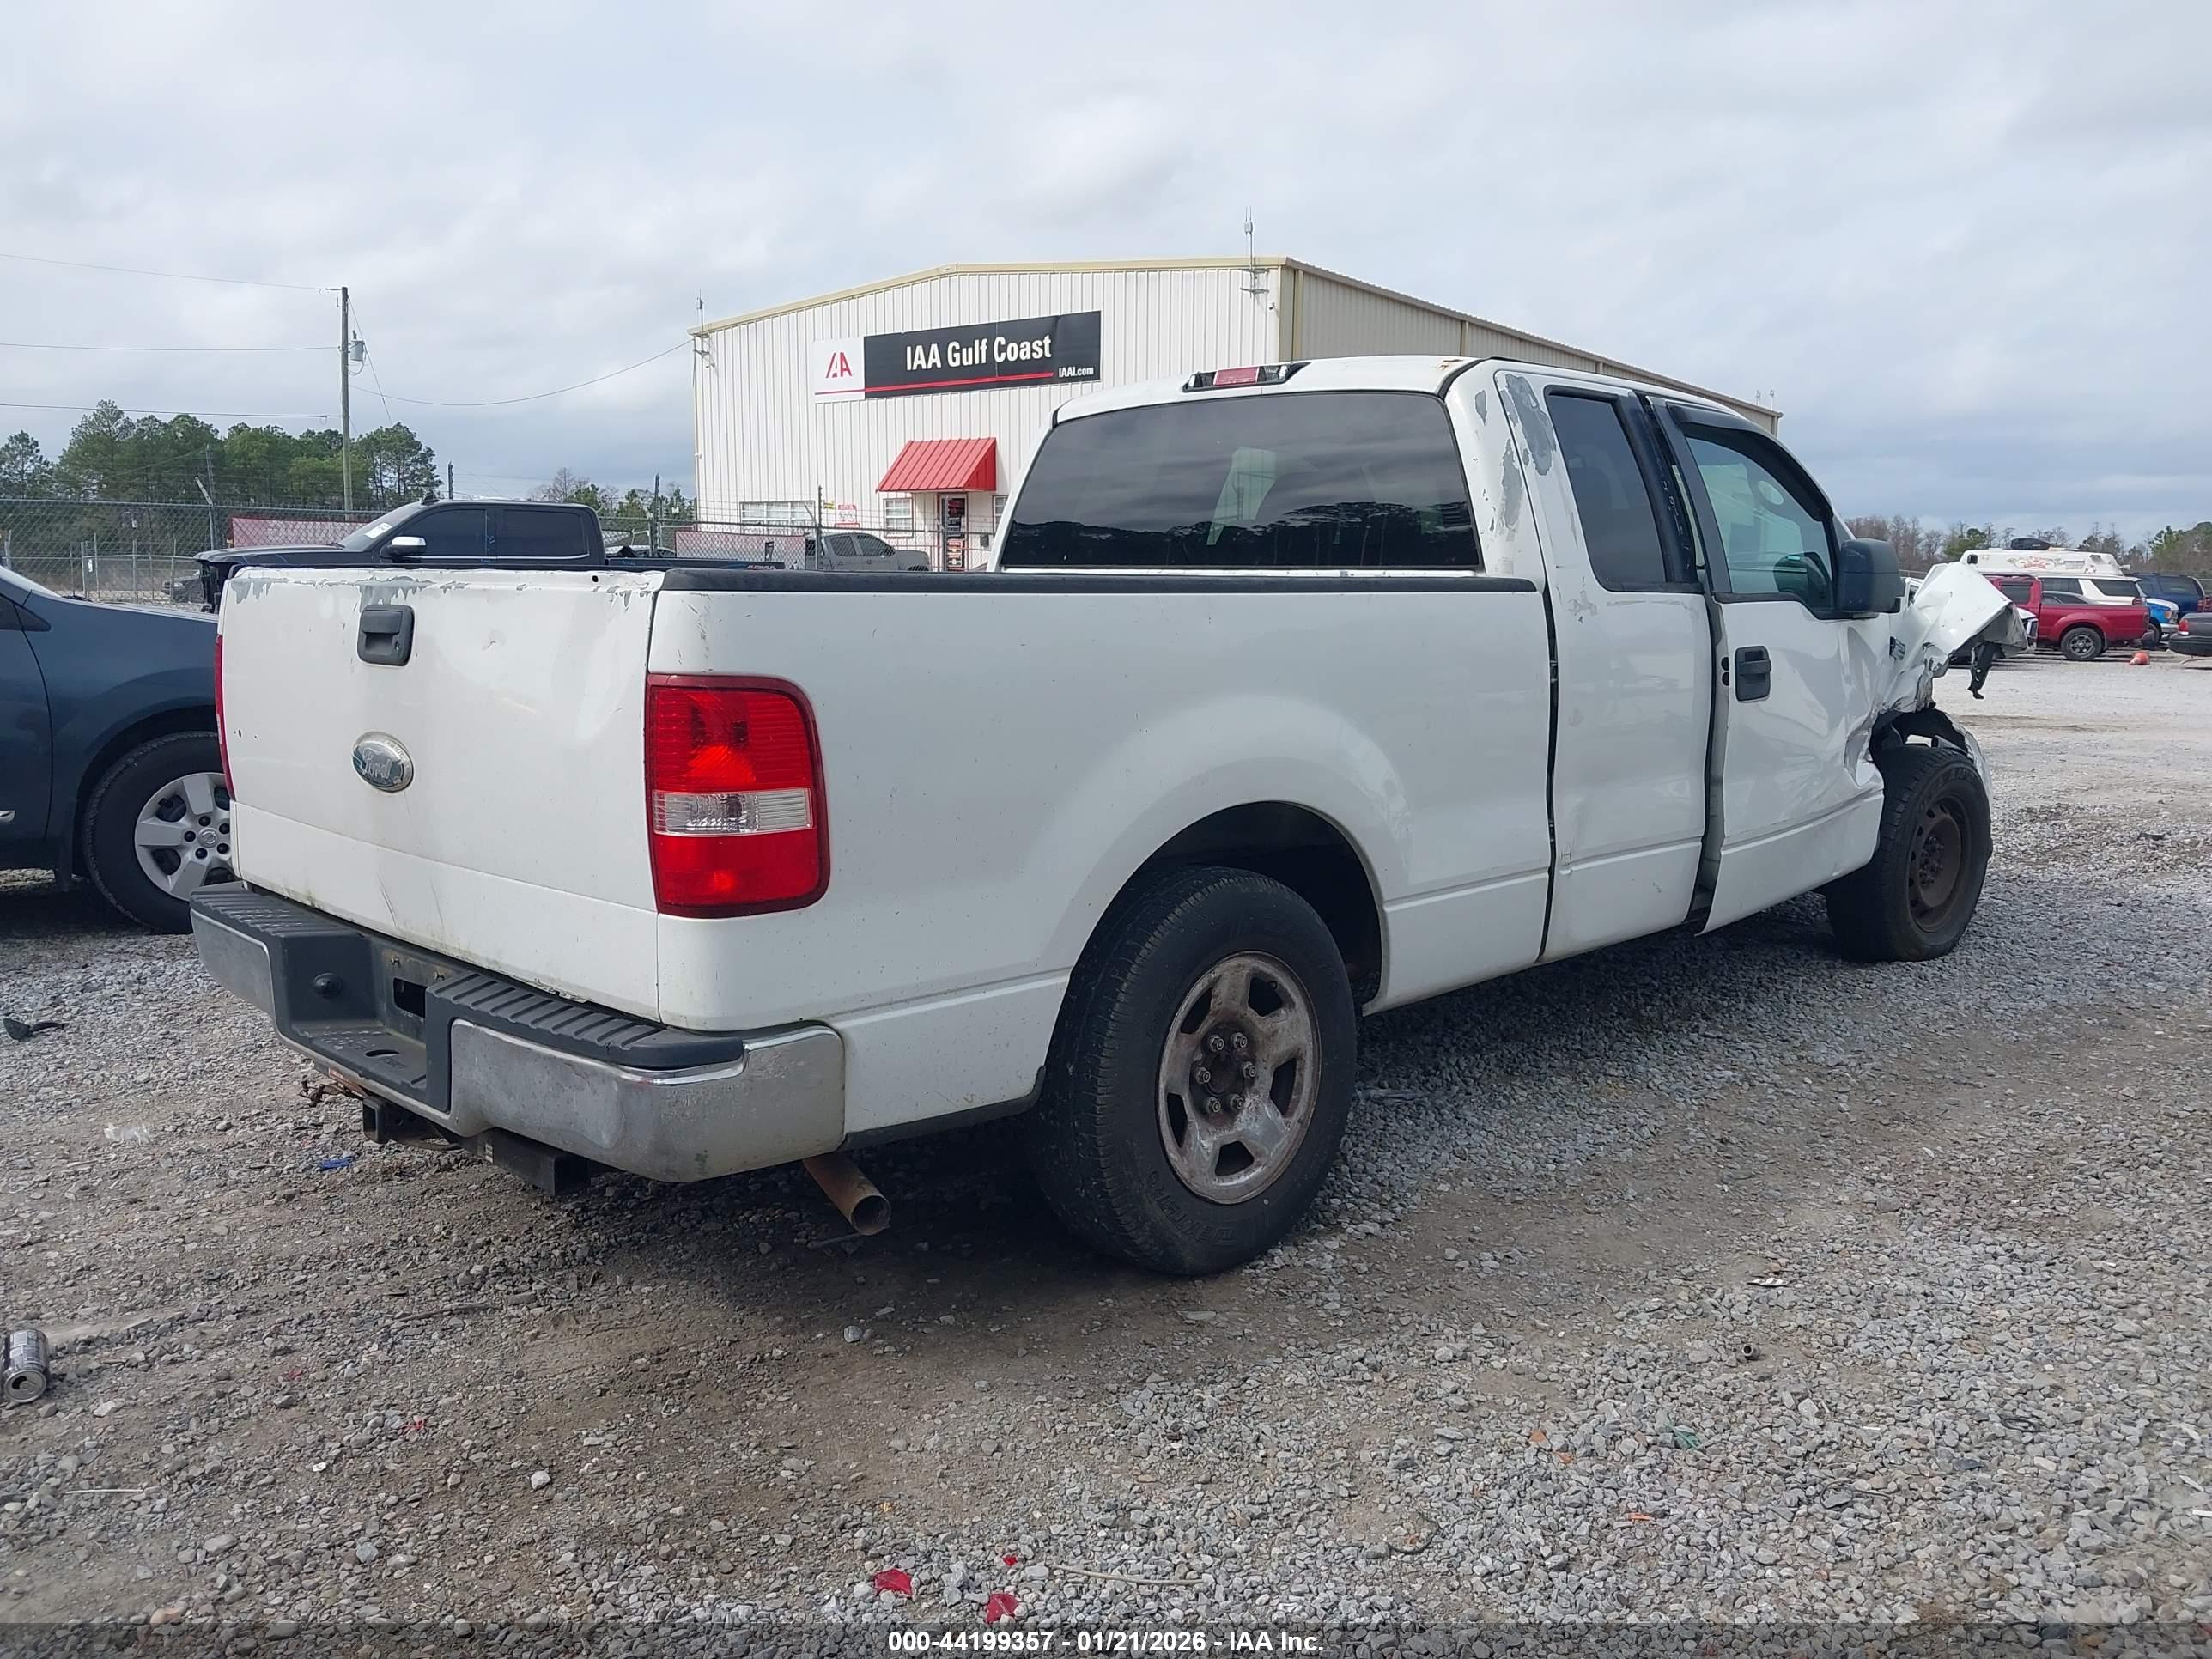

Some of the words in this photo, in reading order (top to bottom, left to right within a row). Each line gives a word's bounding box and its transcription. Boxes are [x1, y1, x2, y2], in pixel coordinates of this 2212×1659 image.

[906, 343, 942, 371] IAA
[947, 338, 988, 367] Gulf
[994, 335, 1052, 362] Coast
[1058, 366, 1095, 378] IAAI.com
